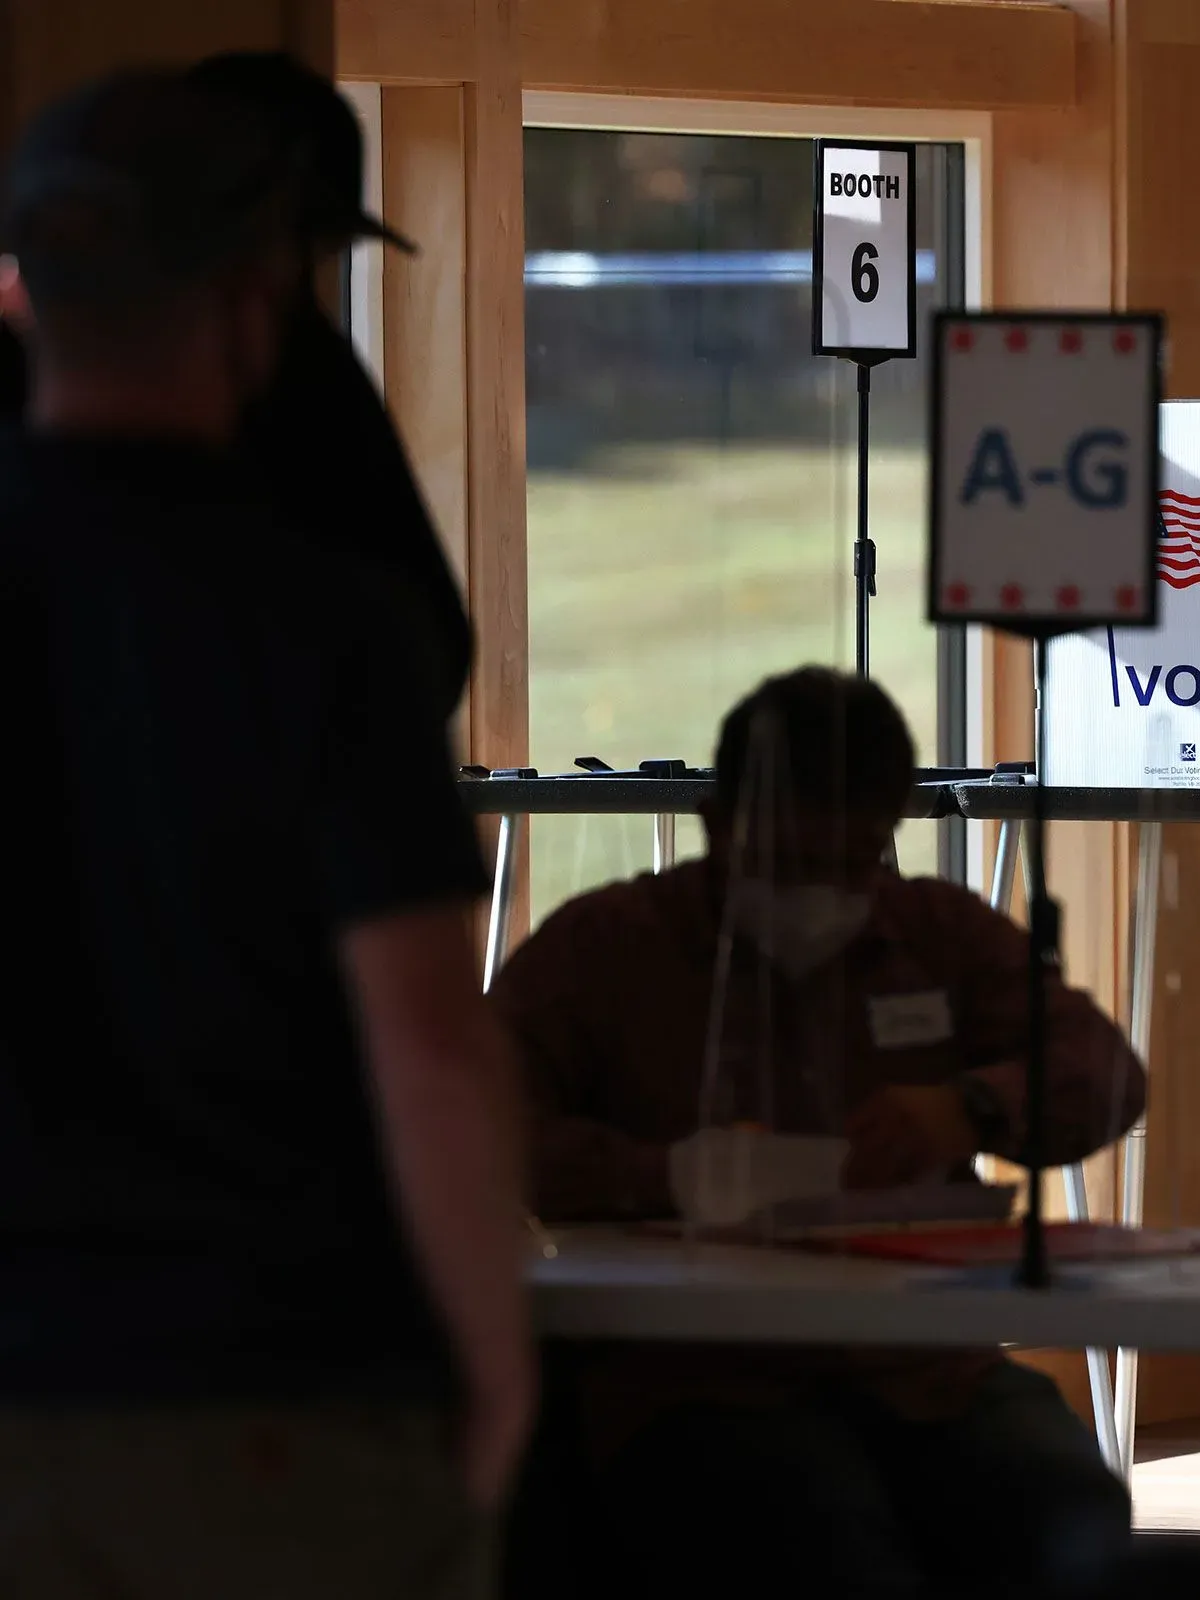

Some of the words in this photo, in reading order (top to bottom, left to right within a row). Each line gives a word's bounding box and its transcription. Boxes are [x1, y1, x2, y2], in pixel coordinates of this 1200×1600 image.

[830, 173, 899, 199] BOOTH
[851, 242, 879, 303] 6
[960, 425, 1129, 510] A-G
[1144, 766, 1169, 774] Select
